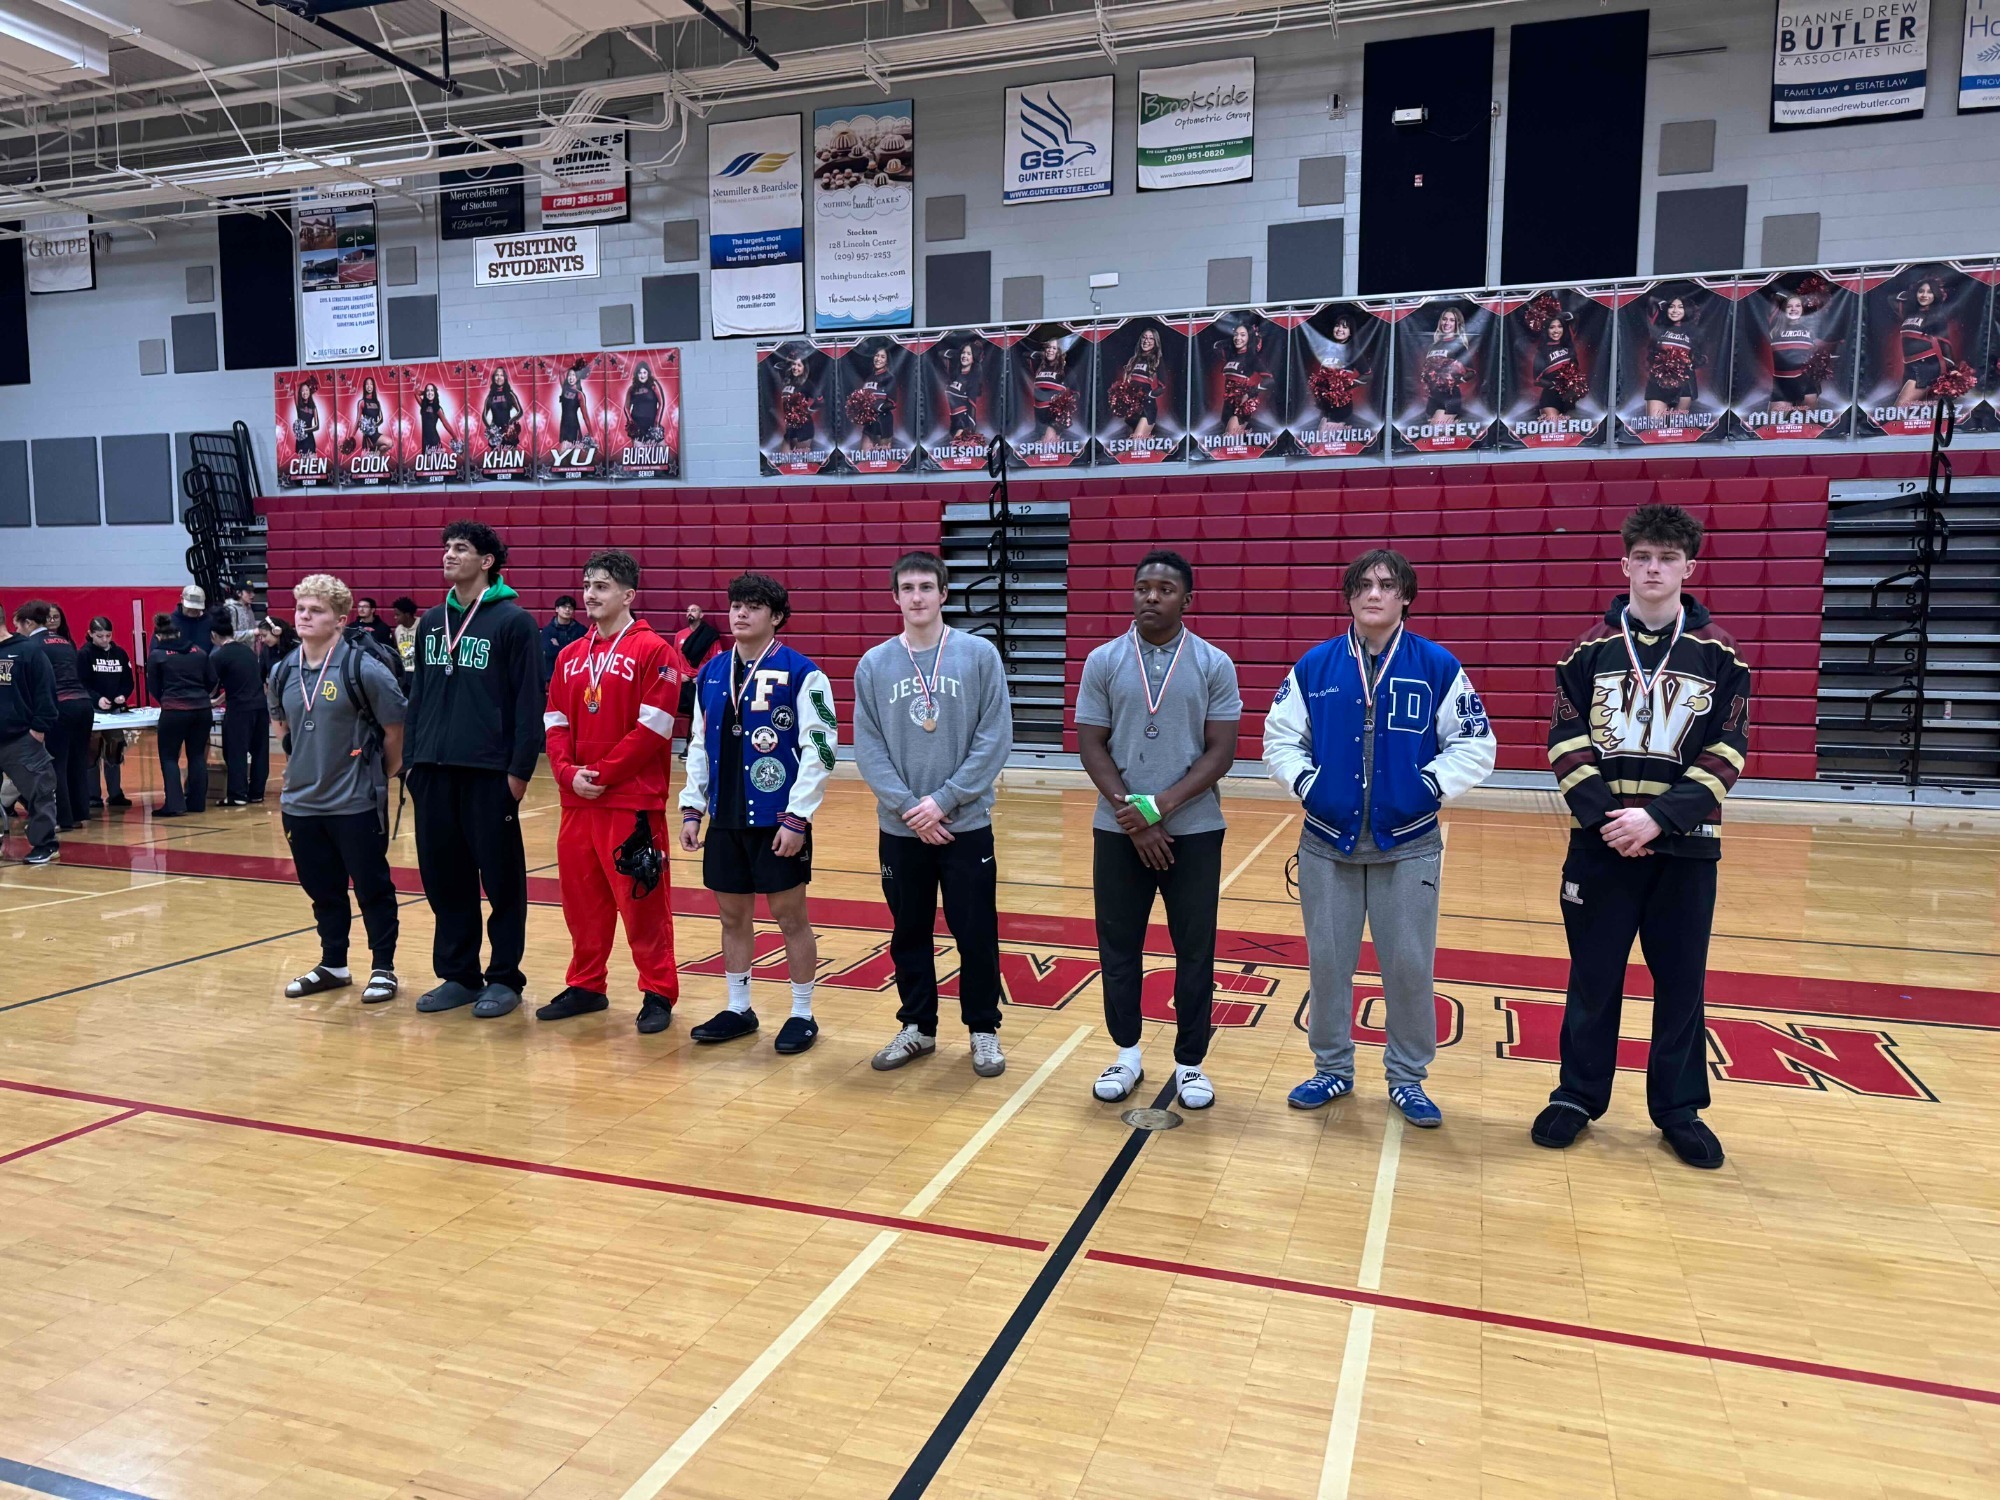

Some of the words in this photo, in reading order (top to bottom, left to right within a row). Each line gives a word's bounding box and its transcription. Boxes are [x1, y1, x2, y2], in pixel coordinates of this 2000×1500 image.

[1782, 8, 1854, 28] DIANNE
[1864, 1, 1918, 19] DREW
[1780, 16, 1916, 53] BUTLER
[1778, 57, 1786, 66] &
[1794, 46, 1880, 66] ASSOCIATES
[1887, 44, 1918, 56] INC.
[1784, 88, 1815, 98] FAMILY
[1818, 85, 1838, 95] LAW
[1855, 80, 1885, 91] ESTATE
[1887, 78, 1908, 88] LAW
[1144, 84, 1249, 118] Brookside
[1782, 96, 1910, 116] www.diannedrewbutler.com
[1174, 114, 1222, 130] Optometric
[1226, 111, 1251, 122] Group
[1020, 148, 1064, 170] GS
[1164, 154, 1184, 164] (209)
[1187, 149, 1225, 160] 951-0820
[1018, 170, 1064, 183] GUNTERT
[1066, 167, 1096, 178] STEEL
[450, 187, 509, 200] Mercedes-Benz
[713, 187, 751, 197] Neumiller
[752, 186, 759, 194] &
[761, 181, 798, 193] Beardslee
[1010, 183, 1105, 198] WWW.GUNTERTSTEEL.COM
[462, 203, 469, 211] of
[469, 200, 498, 210] Stockton
[847, 228, 878, 236] Stockton
[28, 238, 87, 258] GRUPE
[494, 236, 577, 258] VISITING
[744, 237, 765, 246] largest,
[872, 238, 897, 246] Center
[734, 244, 778, 254] comprehensive
[768, 251, 787, 260] region.
[834, 252, 854, 260] (209)
[856, 251, 891, 260] 957-2253
[488, 254, 584, 278] STUDENTS
[820, 269, 906, 282] nothingbundtcakes.com
[1631, 416, 1667, 430] MARISCAL
[1670, 413, 1712, 428] HERNANDEZ
[1749, 409, 1834, 425] MILANO
[1407, 422, 1481, 439] COFFEY
[1515, 418, 1592, 435] ROMERO
[1204, 432, 1272, 448] HAMILTON
[1301, 429, 1372, 443] VALENZUELA
[1019, 441, 1079, 454] SPRINKLE
[1109, 438, 1173, 451] ESPINOZA
[483, 450, 524, 468] KHAN
[551, 448, 596, 466] YU
[622, 446, 669, 465] BURKUM
[850, 448, 907, 461] TALAMANTES
[290, 458, 327, 474] CHEN
[351, 456, 390, 473] COOK
[415, 453, 457, 471] OLIVAS
[1898, 482, 1915, 493] 12
[1019, 506, 1031, 514] 12
[1011, 527, 1024, 536] 11
[1010, 550, 1024, 560] 10
[1011, 573, 1019, 583] 9
[1011, 595, 1018, 606] 8
[1905, 592, 1916, 605] 8
[1010, 618, 1017, 628] 7
[425, 634, 491, 670] RAMS
[1010, 640, 1017, 650] 6
[1904, 649, 1915, 661] 6
[92, 664, 122, 673] WRESTLING
[1010, 664, 1017, 674] 5
[751, 670, 789, 711] F
[889, 675, 960, 704] JESUIT
[1009, 686, 1017, 696] 4
[1388, 678, 1432, 734] D
[1456, 692, 1484, 718] 16
[1902, 704, 1913, 716] 4
[1459, 718, 1490, 738] 17
[1900, 732, 1910, 744] 3
[1899, 760, 1910, 774] 2
[1908, 790, 1915, 802] 1
